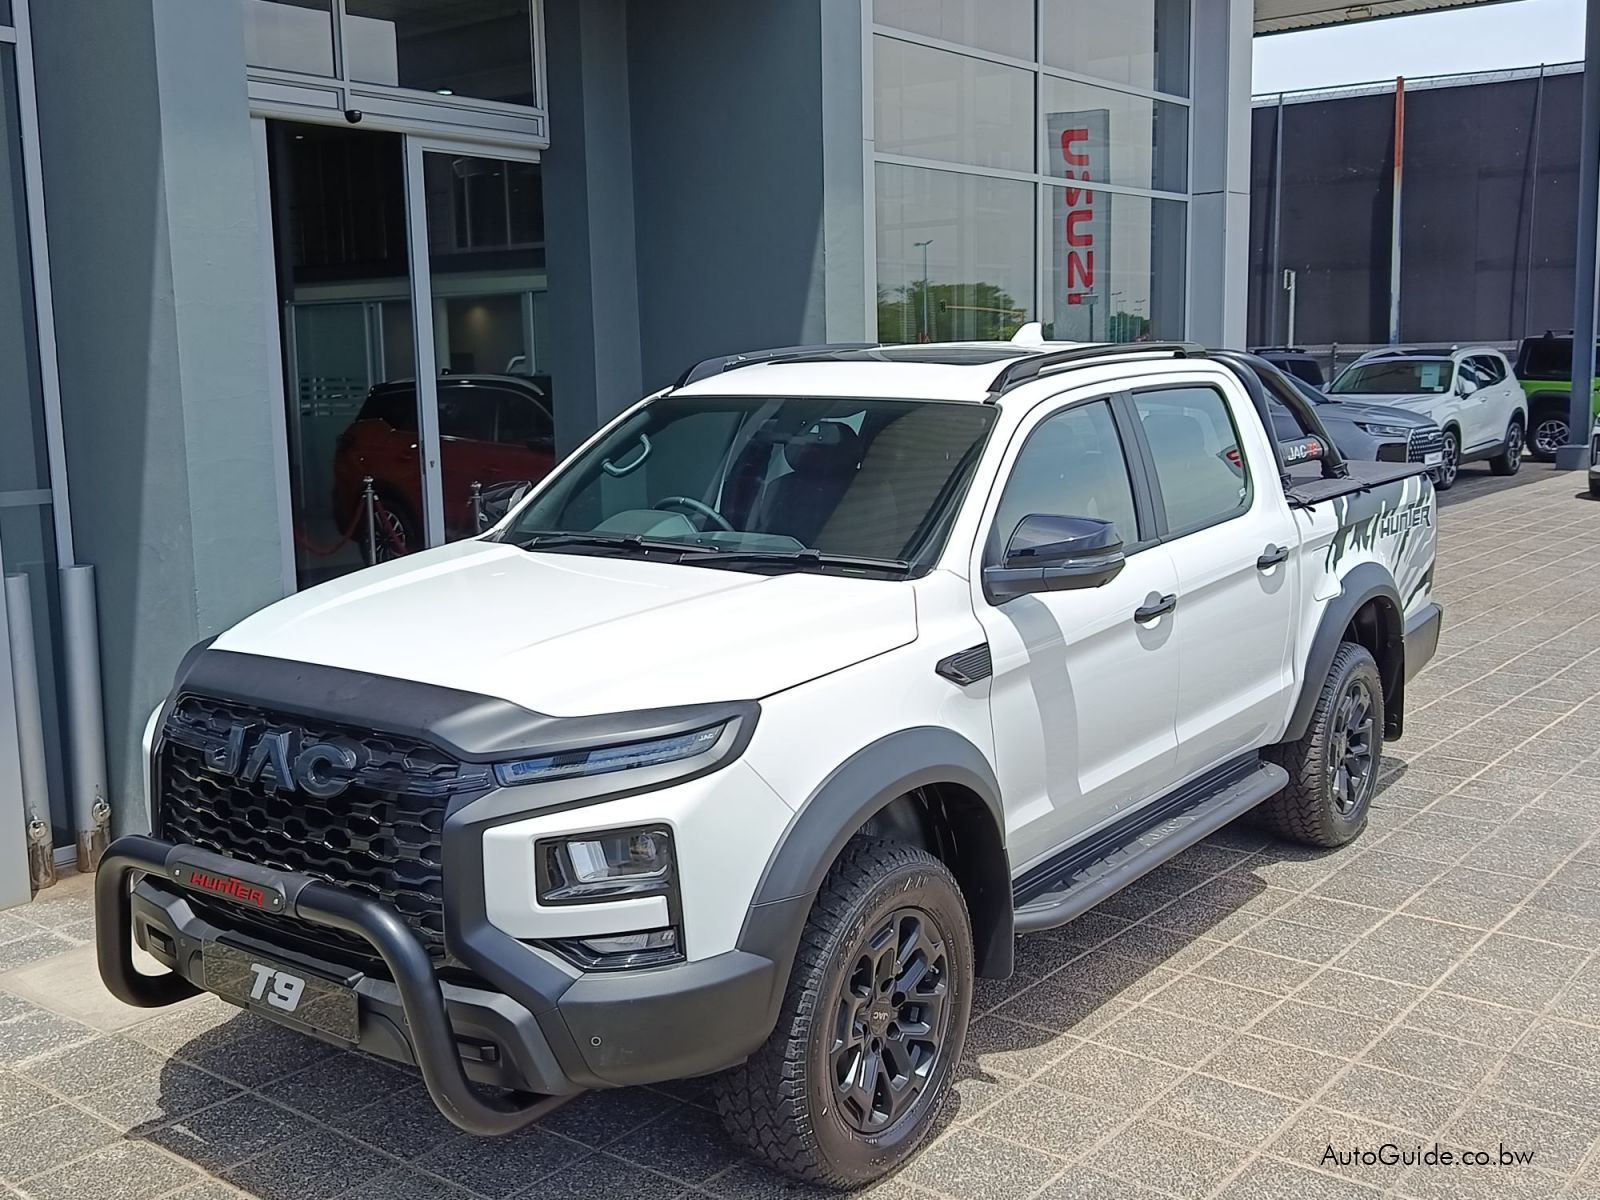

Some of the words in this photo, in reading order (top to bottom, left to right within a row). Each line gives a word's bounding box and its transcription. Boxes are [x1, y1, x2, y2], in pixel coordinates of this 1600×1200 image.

[1287, 444, 1306, 461] JAC
[1380, 502, 1431, 539] HUNTER
[698, 733, 714, 742] JAC
[204, 723, 357, 799] JAC
[190, 871, 264, 908] HUNTER
[250, 963, 306, 1013] T9
[872, 1011, 889, 1021] JAC
